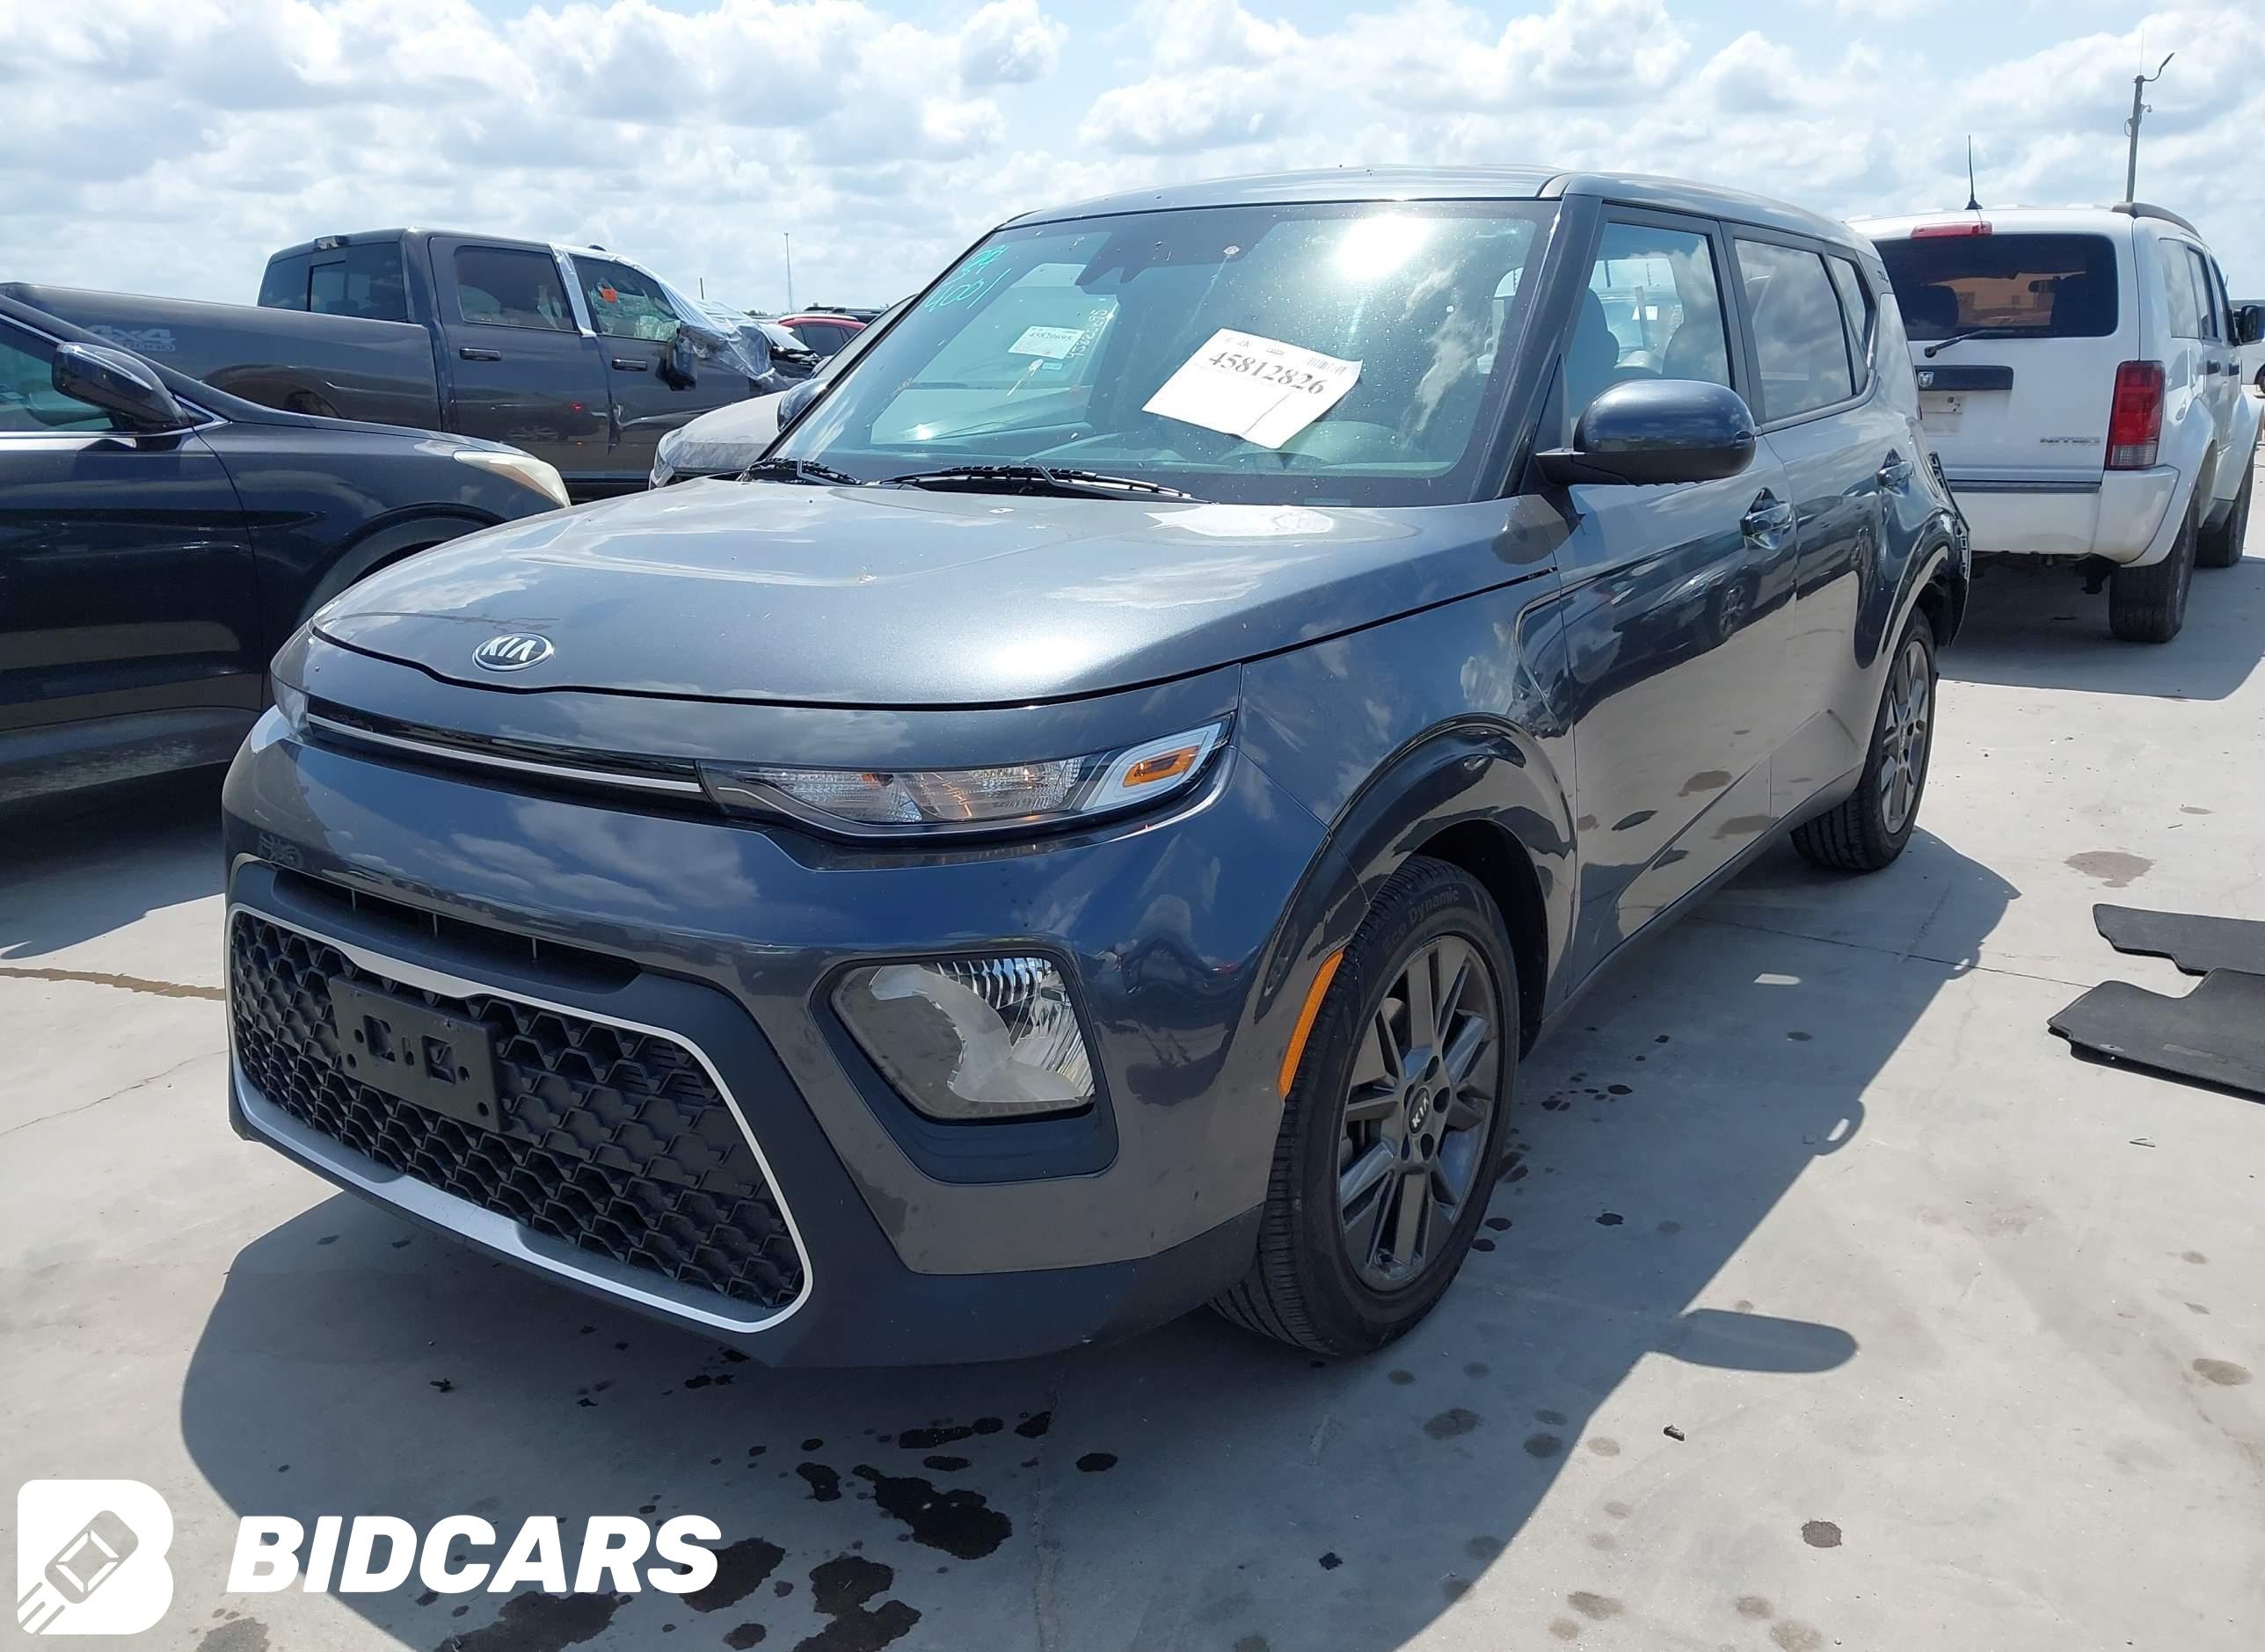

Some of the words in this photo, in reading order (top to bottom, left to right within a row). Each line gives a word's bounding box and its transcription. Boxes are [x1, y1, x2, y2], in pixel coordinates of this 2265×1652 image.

[1208, 351, 1329, 395] 45812826
[480, 637, 537, 661] KIA
[1408, 886, 1460, 923] Dynamic
[1412, 1097, 1429, 1128] KIA
